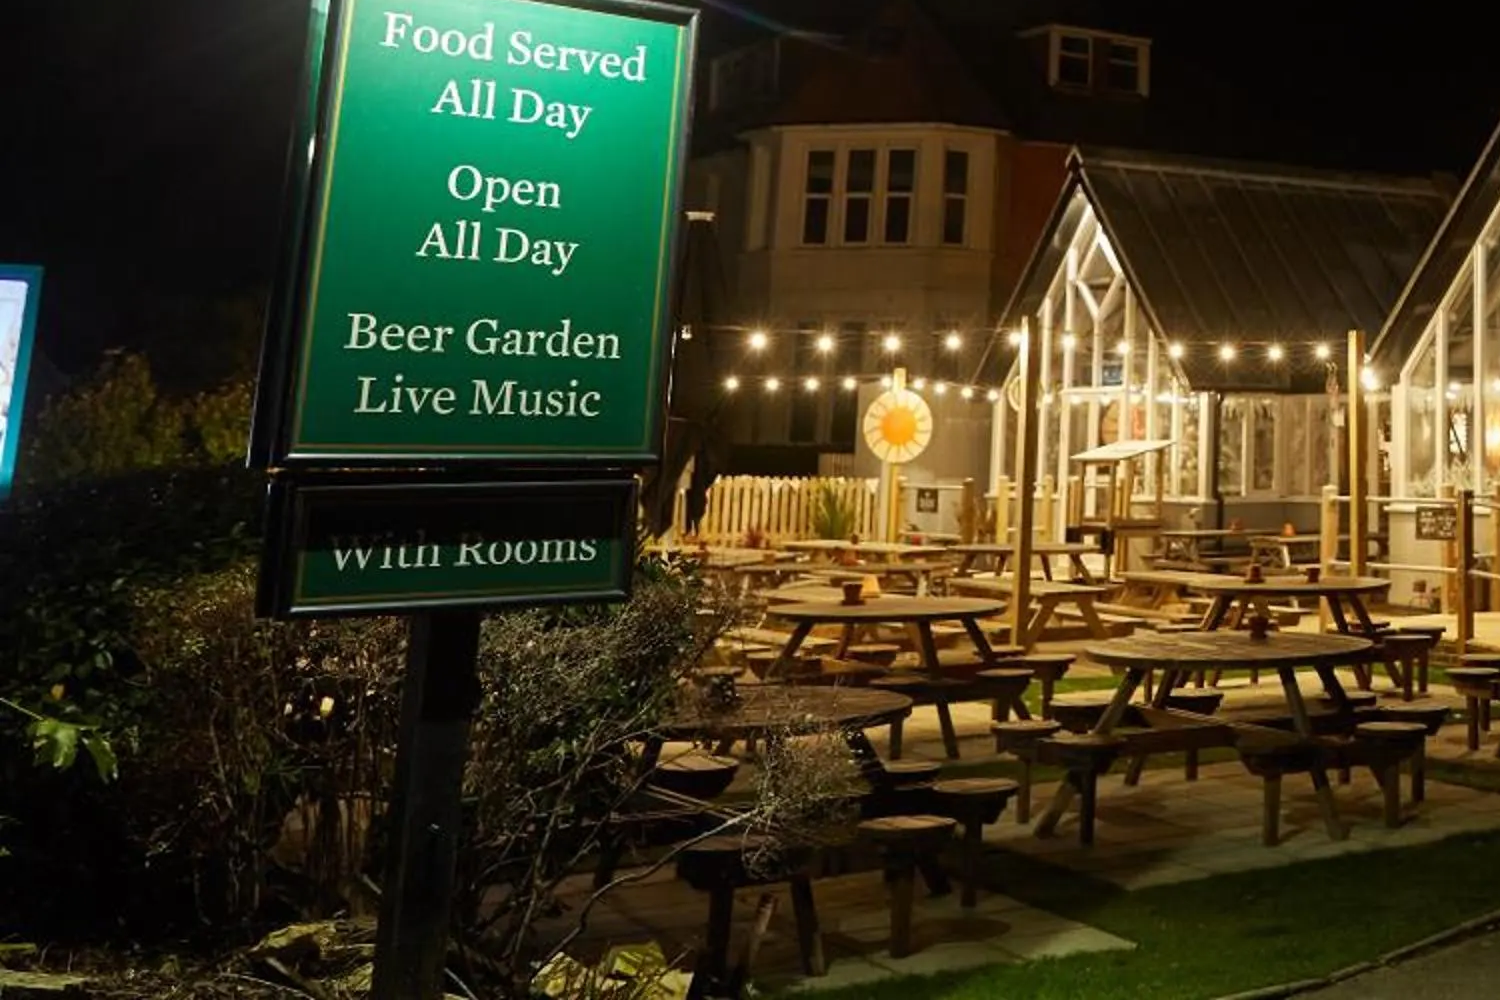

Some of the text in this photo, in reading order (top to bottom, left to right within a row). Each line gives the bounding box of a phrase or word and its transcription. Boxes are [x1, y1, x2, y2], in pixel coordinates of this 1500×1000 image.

[380, 10, 648, 83] Food Served
[430, 77, 594, 139] All Day
[447, 164, 561, 213] Open
[415, 219, 579, 276] All Day
[342, 312, 622, 360] Beer Garden
[352, 374, 602, 417] Live Music
[452, 528, 598, 568] Rooms
